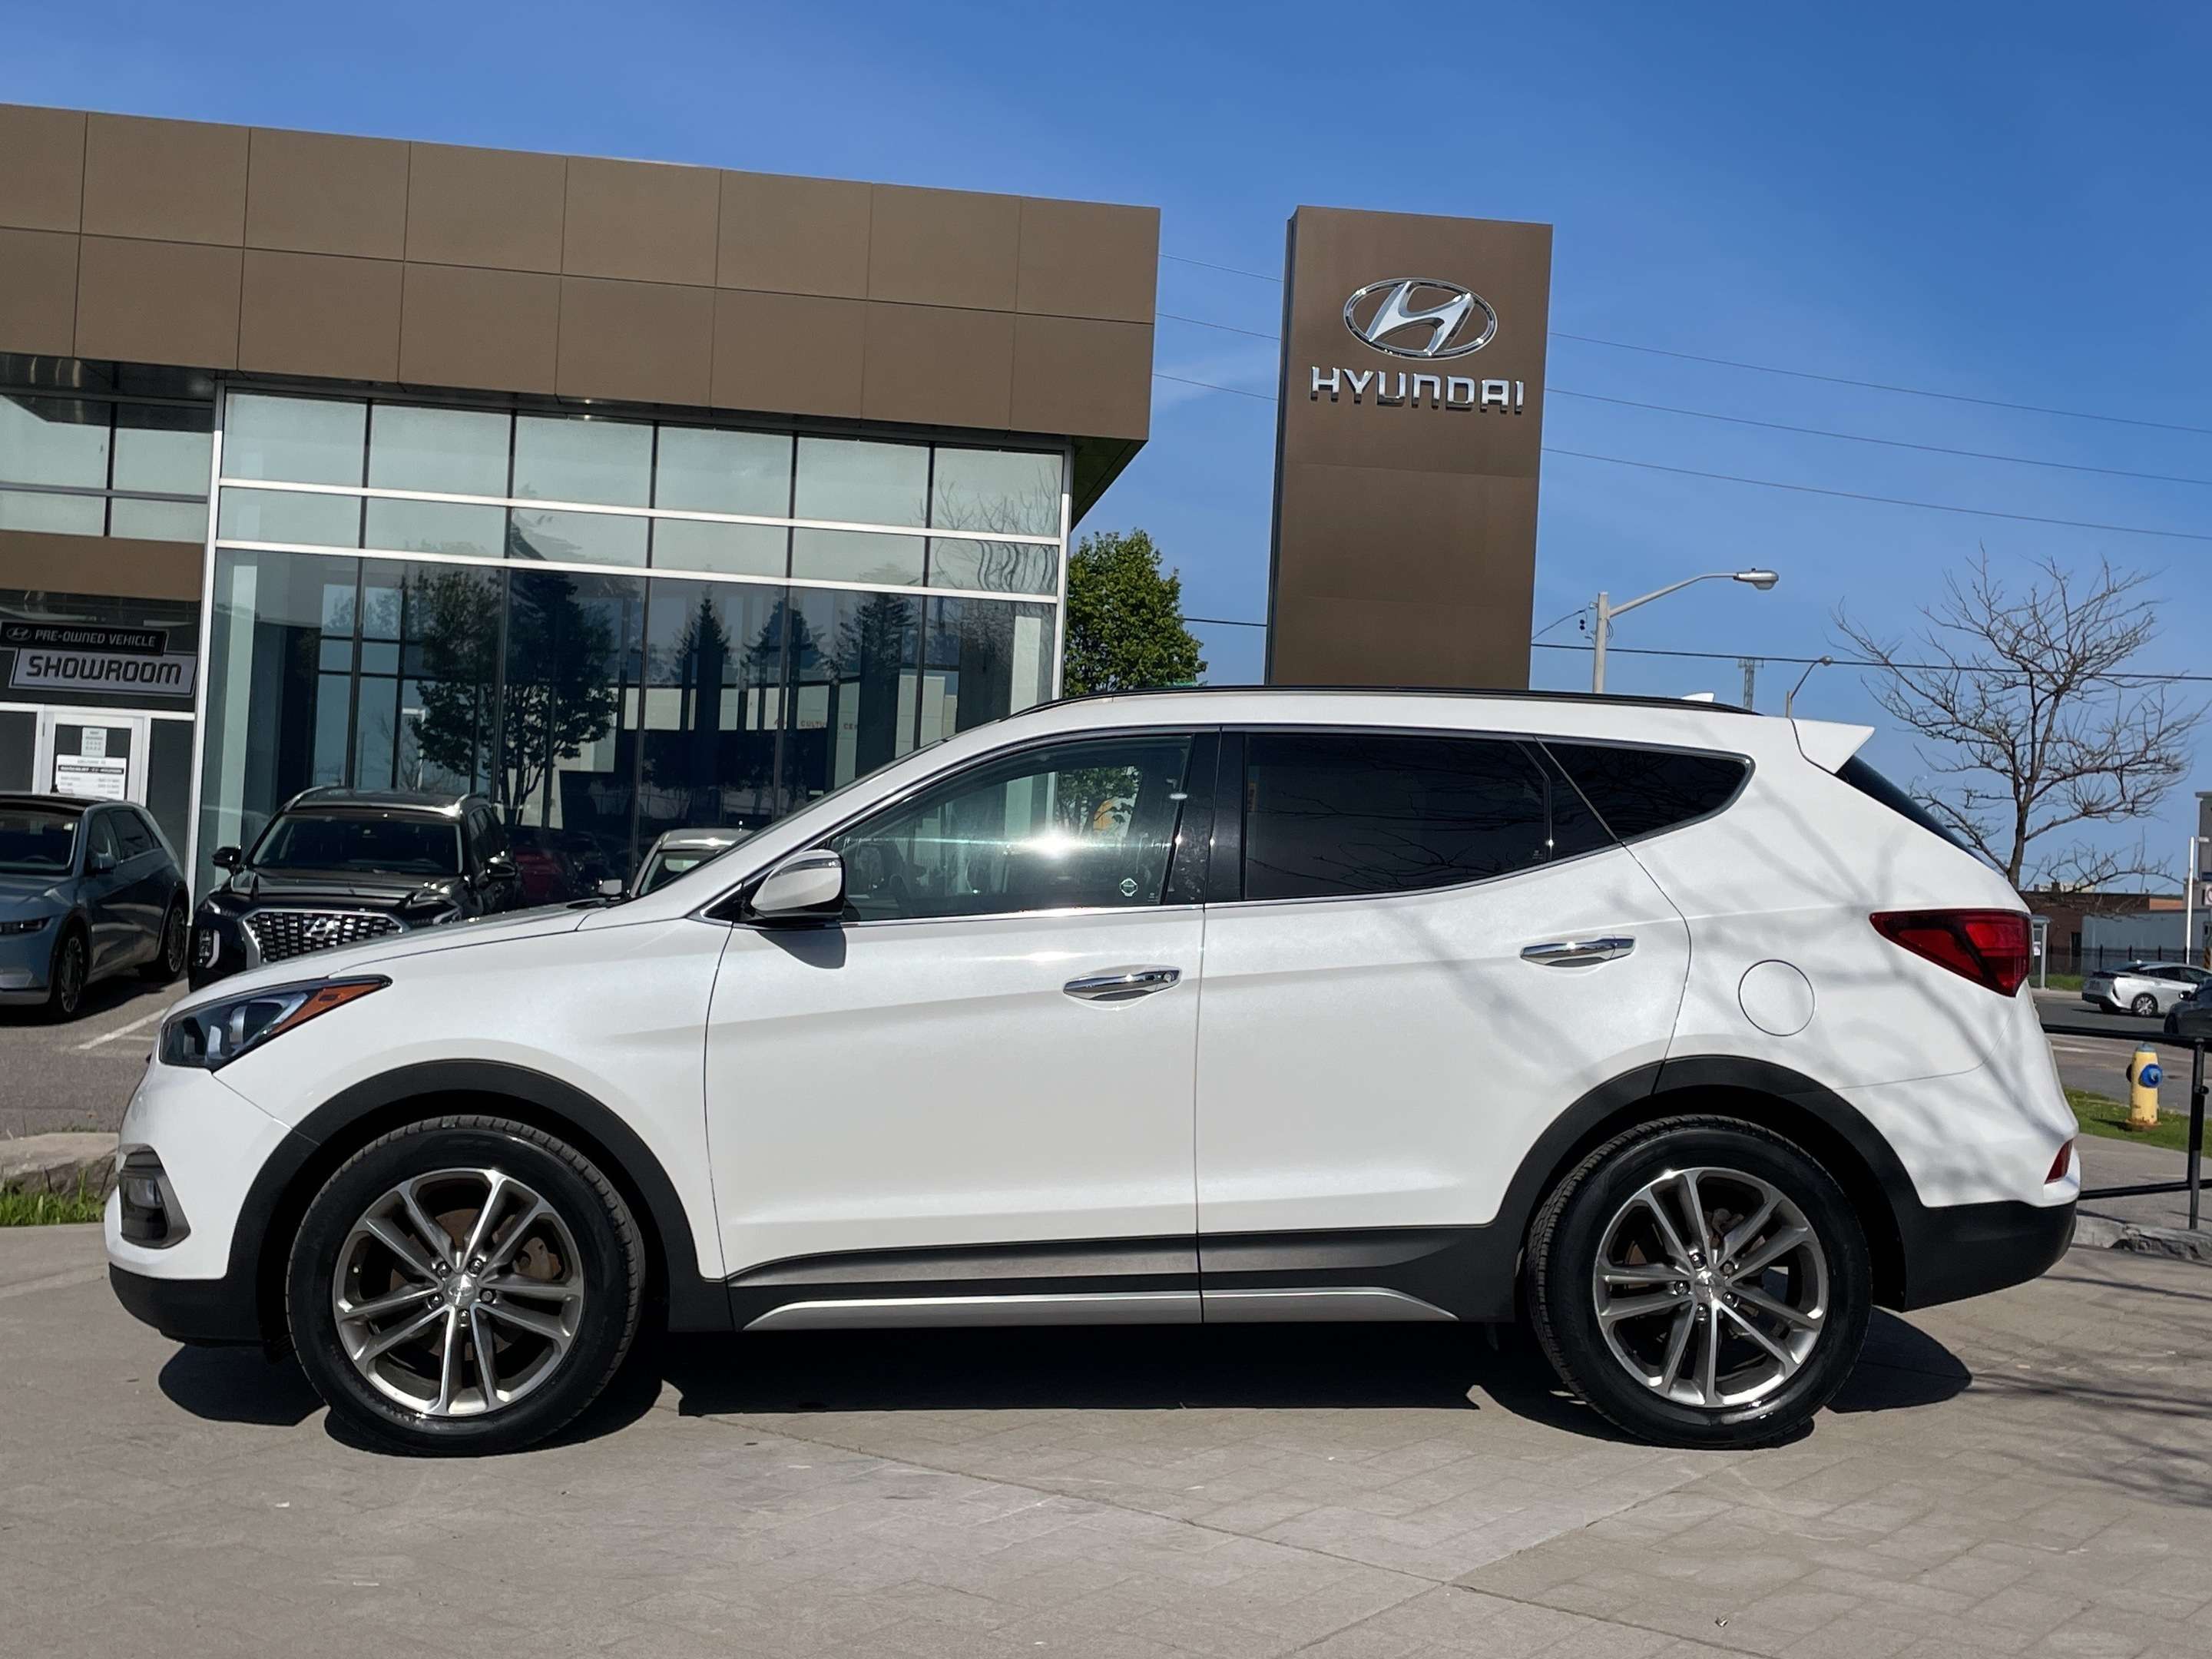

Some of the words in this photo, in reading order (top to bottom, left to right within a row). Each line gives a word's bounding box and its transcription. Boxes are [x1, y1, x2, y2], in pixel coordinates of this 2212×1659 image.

[1310, 366, 1525, 415] HYUNDAI
[35, 629, 105, 644] PRE-OWNED
[109, 633, 156, 647] VEHICLE
[26, 655, 182, 685] SHOWROOM
